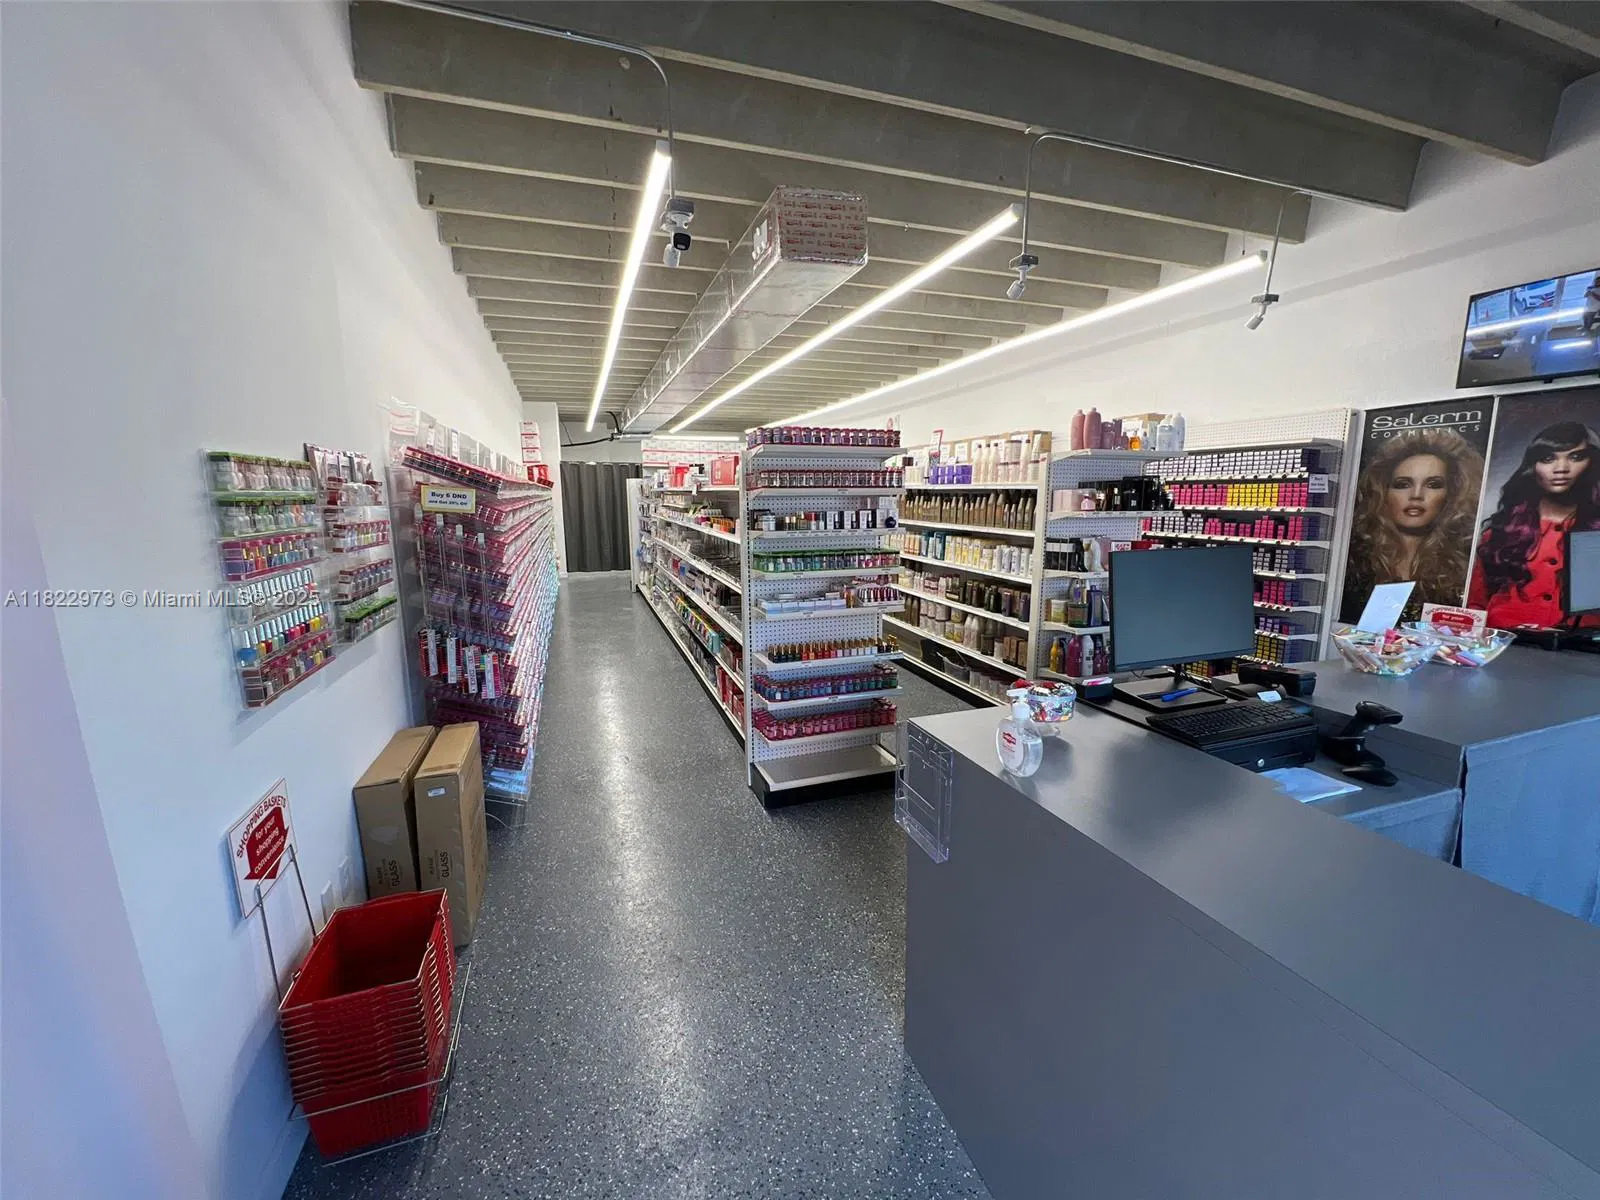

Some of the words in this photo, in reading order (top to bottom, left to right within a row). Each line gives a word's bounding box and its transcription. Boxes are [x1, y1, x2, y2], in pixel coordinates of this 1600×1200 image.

[1370, 424, 1480, 439] COSMETICS
[237, 806, 263, 858] SHOPPING
[263, 795, 286, 808] BASKETS
[255, 828, 264, 841] for
[263, 816, 275, 834] your
[254, 835, 285, 874] convenience
[256, 826, 280, 857] shopping
[388, 859, 400, 887] GLASS
[439, 850, 450, 878] GLASS
